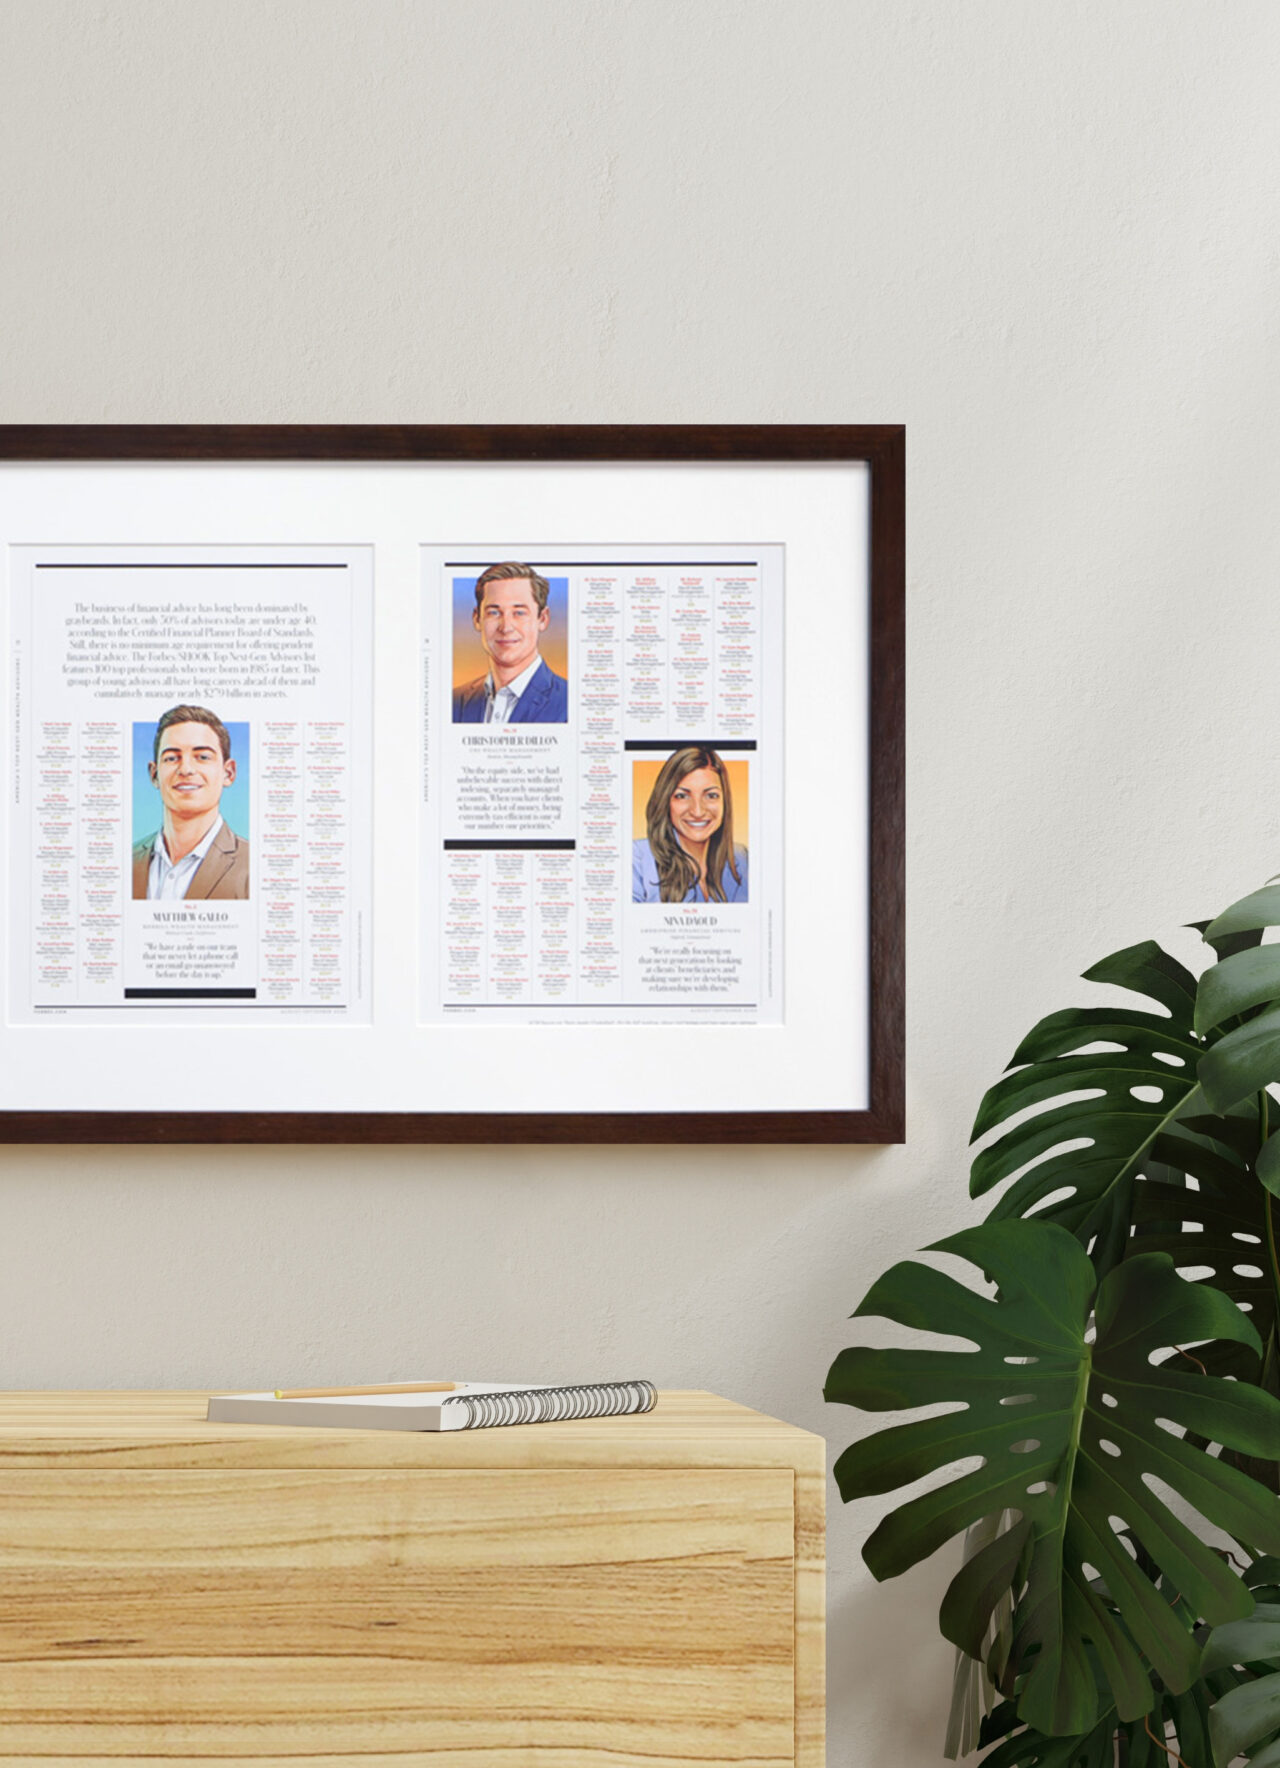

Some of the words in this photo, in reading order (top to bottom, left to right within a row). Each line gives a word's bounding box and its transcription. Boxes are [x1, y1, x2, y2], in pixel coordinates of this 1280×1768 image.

[126, 602, 135, 613] of
[299, 602, 308, 616] by
[112, 614, 120, 625] In
[180, 614, 189, 625] of
[107, 627, 116, 637] to
[263, 626, 271, 637] of
[110, 639, 117, 649] is
[118, 641, 129, 649] no
[240, 664, 248, 674] in
[270, 665, 279, 674] or
[91, 674, 101, 686] of
[268, 674, 277, 686] of
[253, 688, 261, 698] in
[461, 736, 524, 746] CHRISTOPHER
[525, 736, 559, 746] DILLON
[153, 912, 196, 922] MATTHEW
[198, 912, 229, 922] GALLO
[663, 916, 685, 926] NINA
[685, 916, 718, 926] DAOUD
